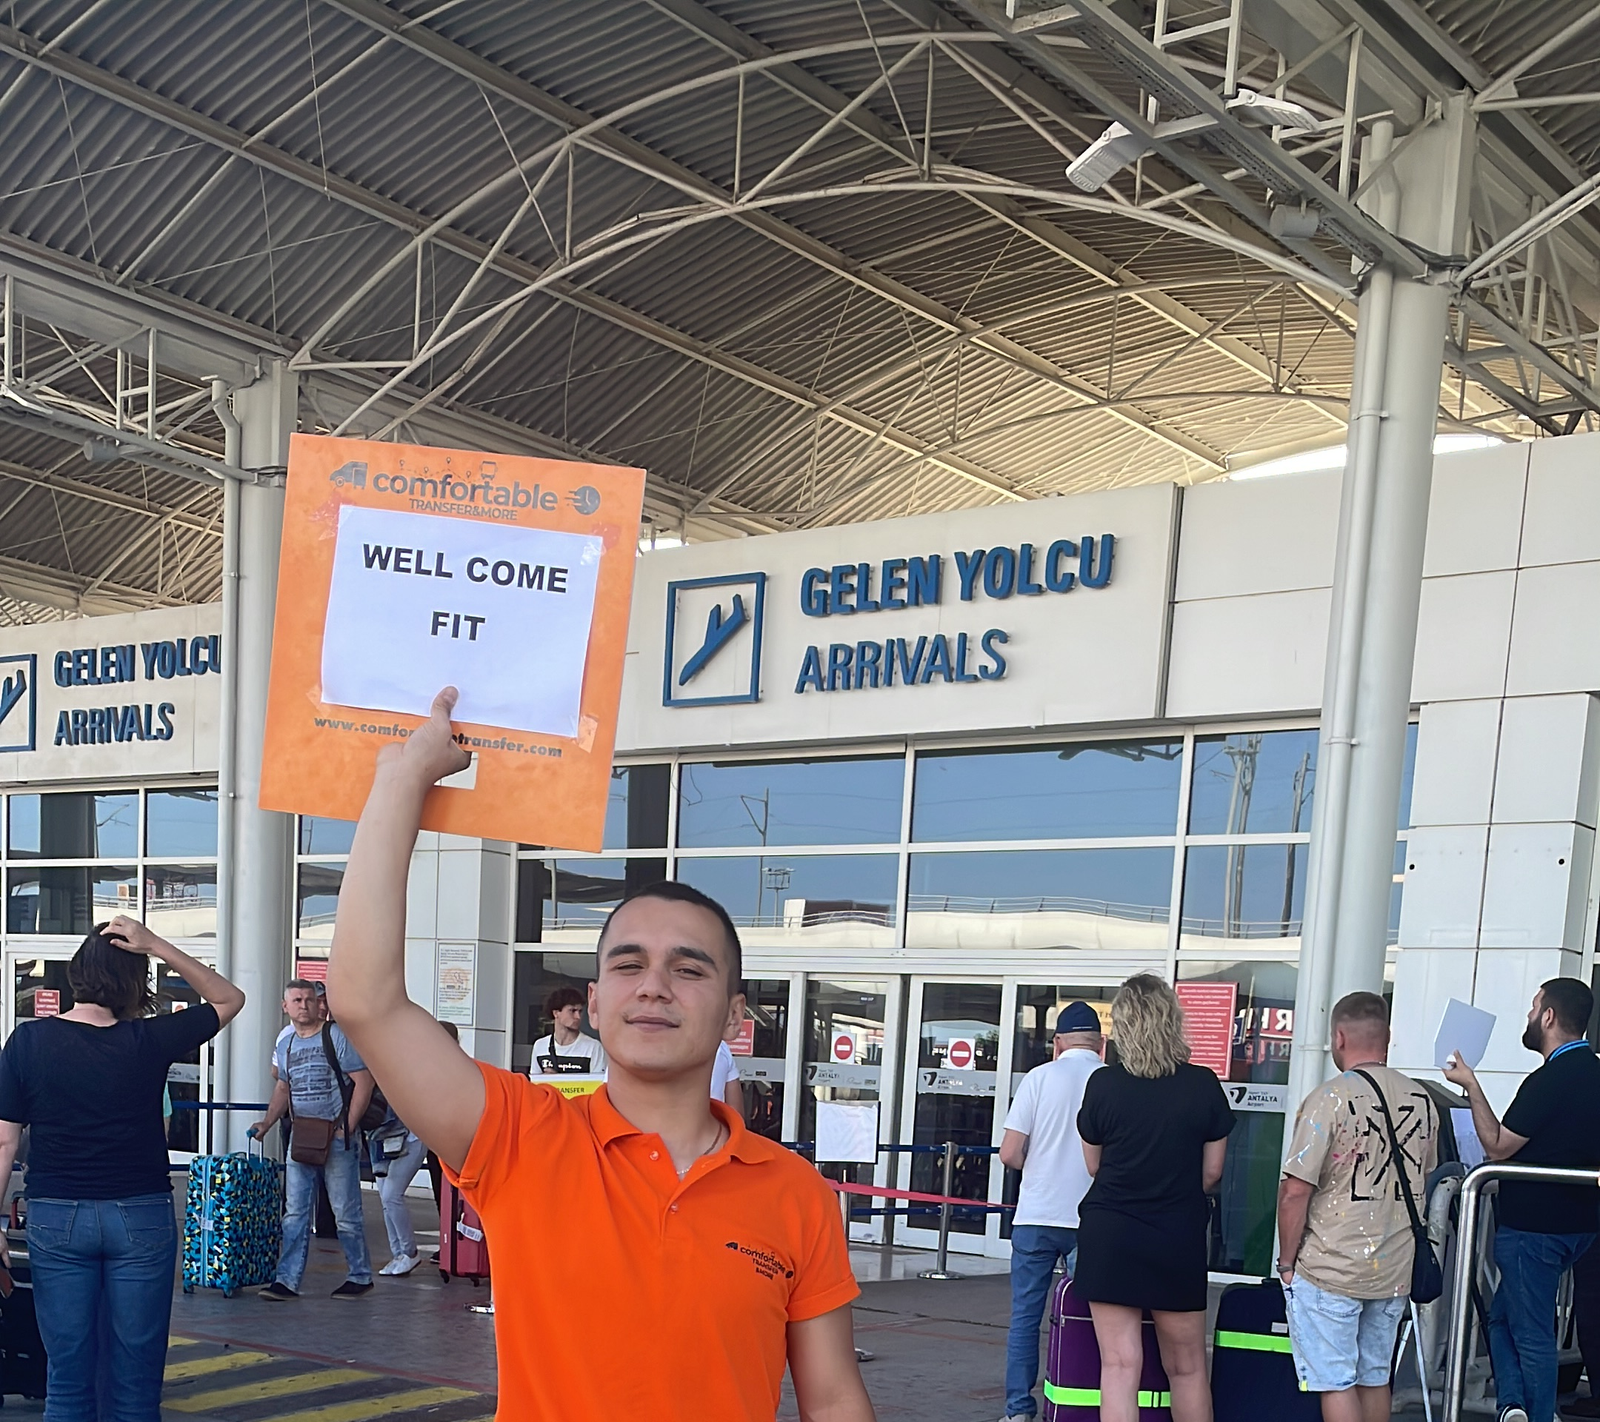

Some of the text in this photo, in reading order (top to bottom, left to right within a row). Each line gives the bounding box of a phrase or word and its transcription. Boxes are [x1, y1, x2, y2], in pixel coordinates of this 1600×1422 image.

[372, 473, 558, 511] comfortable
[409, 498, 518, 521] TRANSFER&MORE
[362, 543, 570, 593] WELL COME
[800, 533, 1115, 617] GELEN YOLCU
[430, 610, 486, 641] FIT
[54, 634, 222, 687] GELEN YOLCU
[794, 628, 1010, 694] ARRIVALS
[54, 702, 176, 746] ARRIVALS
